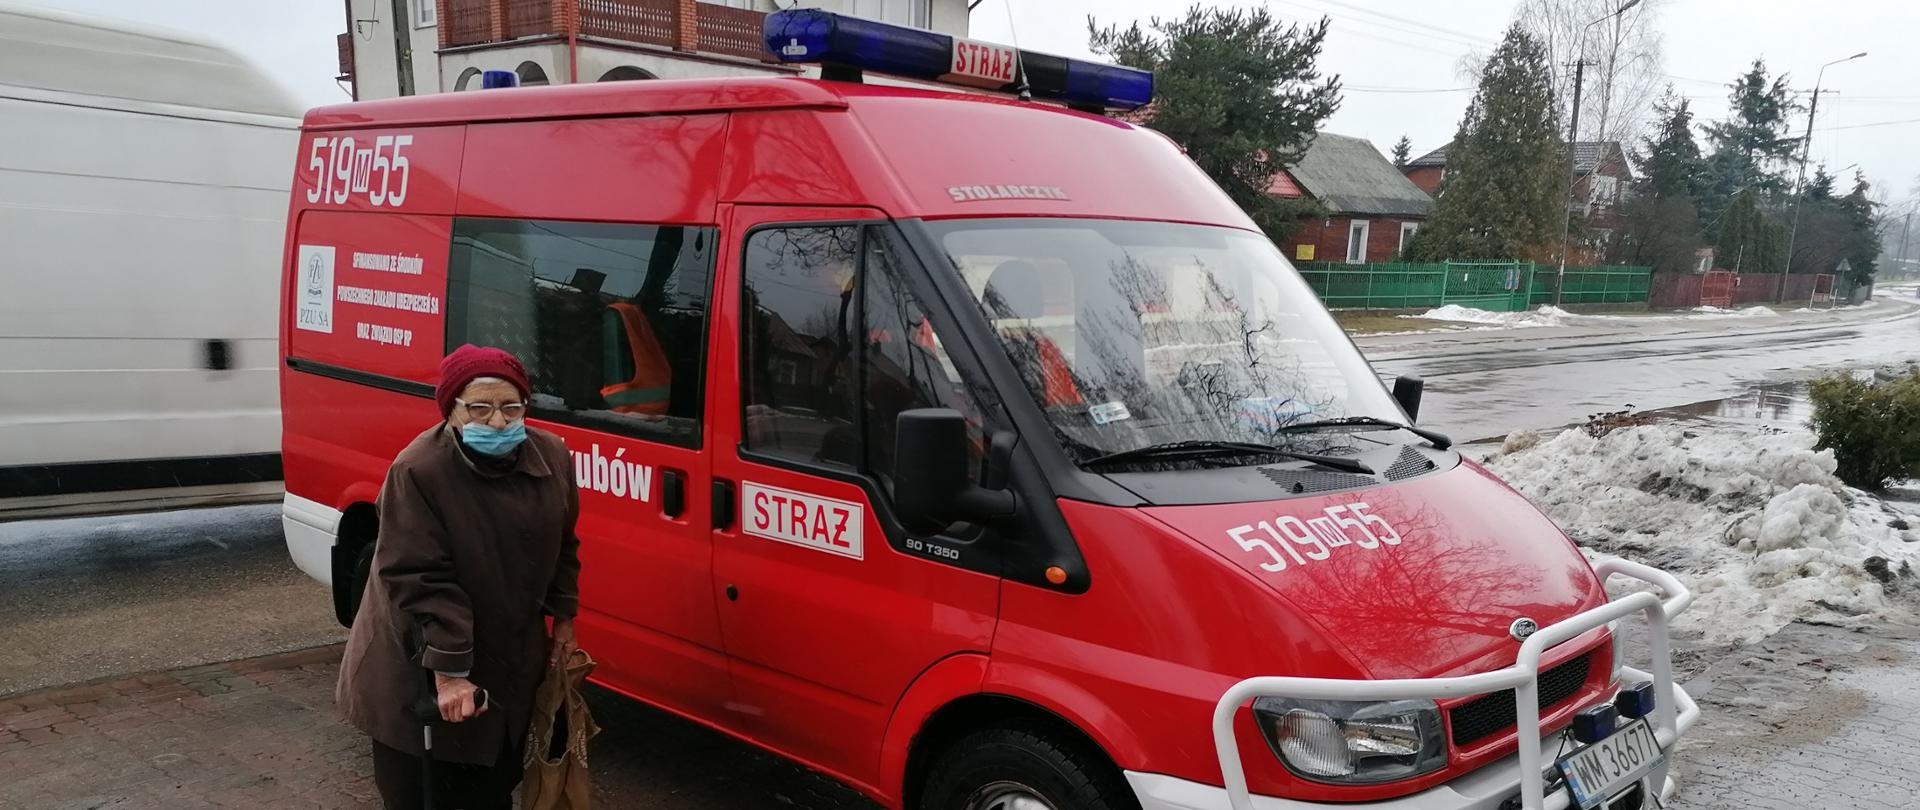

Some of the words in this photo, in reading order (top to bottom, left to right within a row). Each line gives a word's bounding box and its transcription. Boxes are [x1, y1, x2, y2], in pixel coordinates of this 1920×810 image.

[956, 42, 1012, 81] STRAŻ
[948, 185, 1067, 202] STOLARCZYK
[300, 308, 317, 325] PZU
[319, 311, 329, 327] SA
[567, 442, 652, 503] ubów
[754, 491, 850, 548] STRAŻ
[906, 538, 923, 551] 90
[926, 543, 959, 560] T350
[1572, 749, 1609, 794] WM
[1602, 723, 1653, 777] 36677
